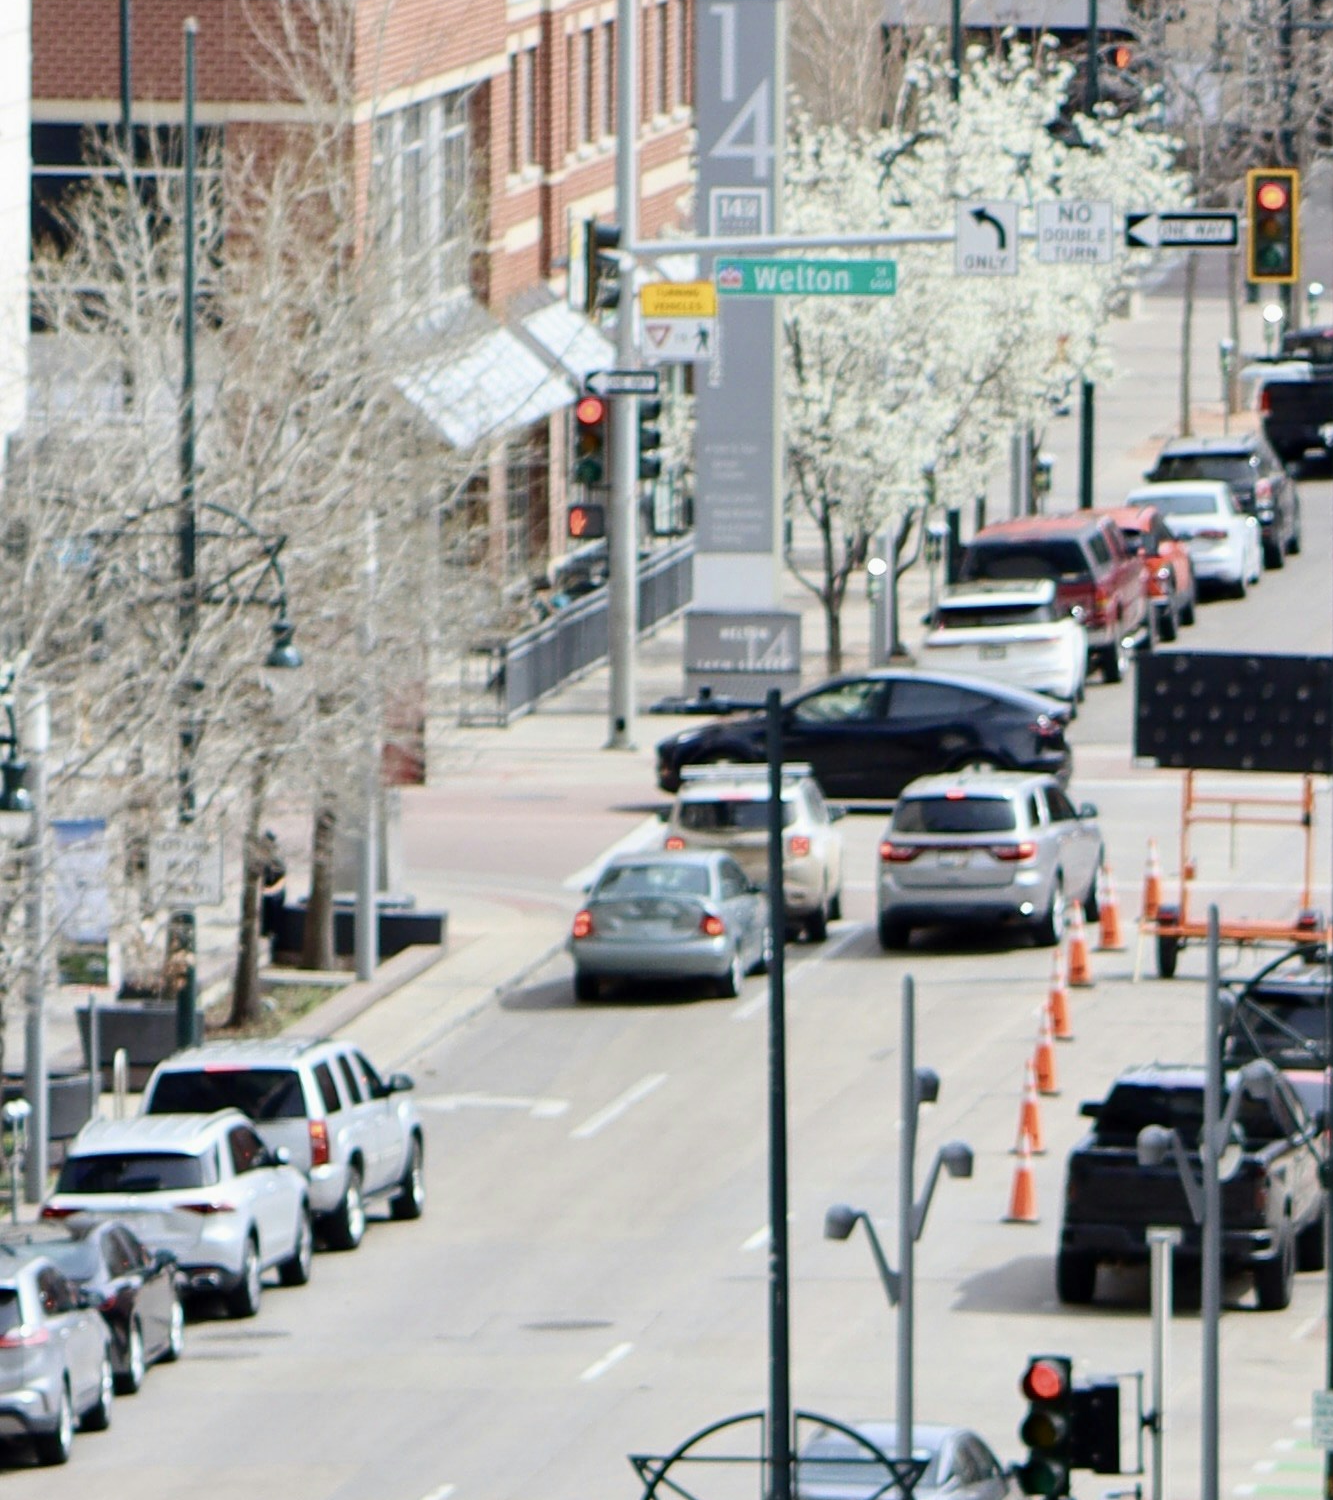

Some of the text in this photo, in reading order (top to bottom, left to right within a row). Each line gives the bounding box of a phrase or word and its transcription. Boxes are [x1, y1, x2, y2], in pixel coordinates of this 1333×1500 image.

[1058, 205, 1092, 223] NO
[1043, 227, 1106, 243] DOUBLE
[1158, 221, 1227, 237] ONE WAY
[1054, 246, 1098, 259] TURN
[964, 254, 1008, 270] ONLY
[754, 265, 850, 291] Welton
